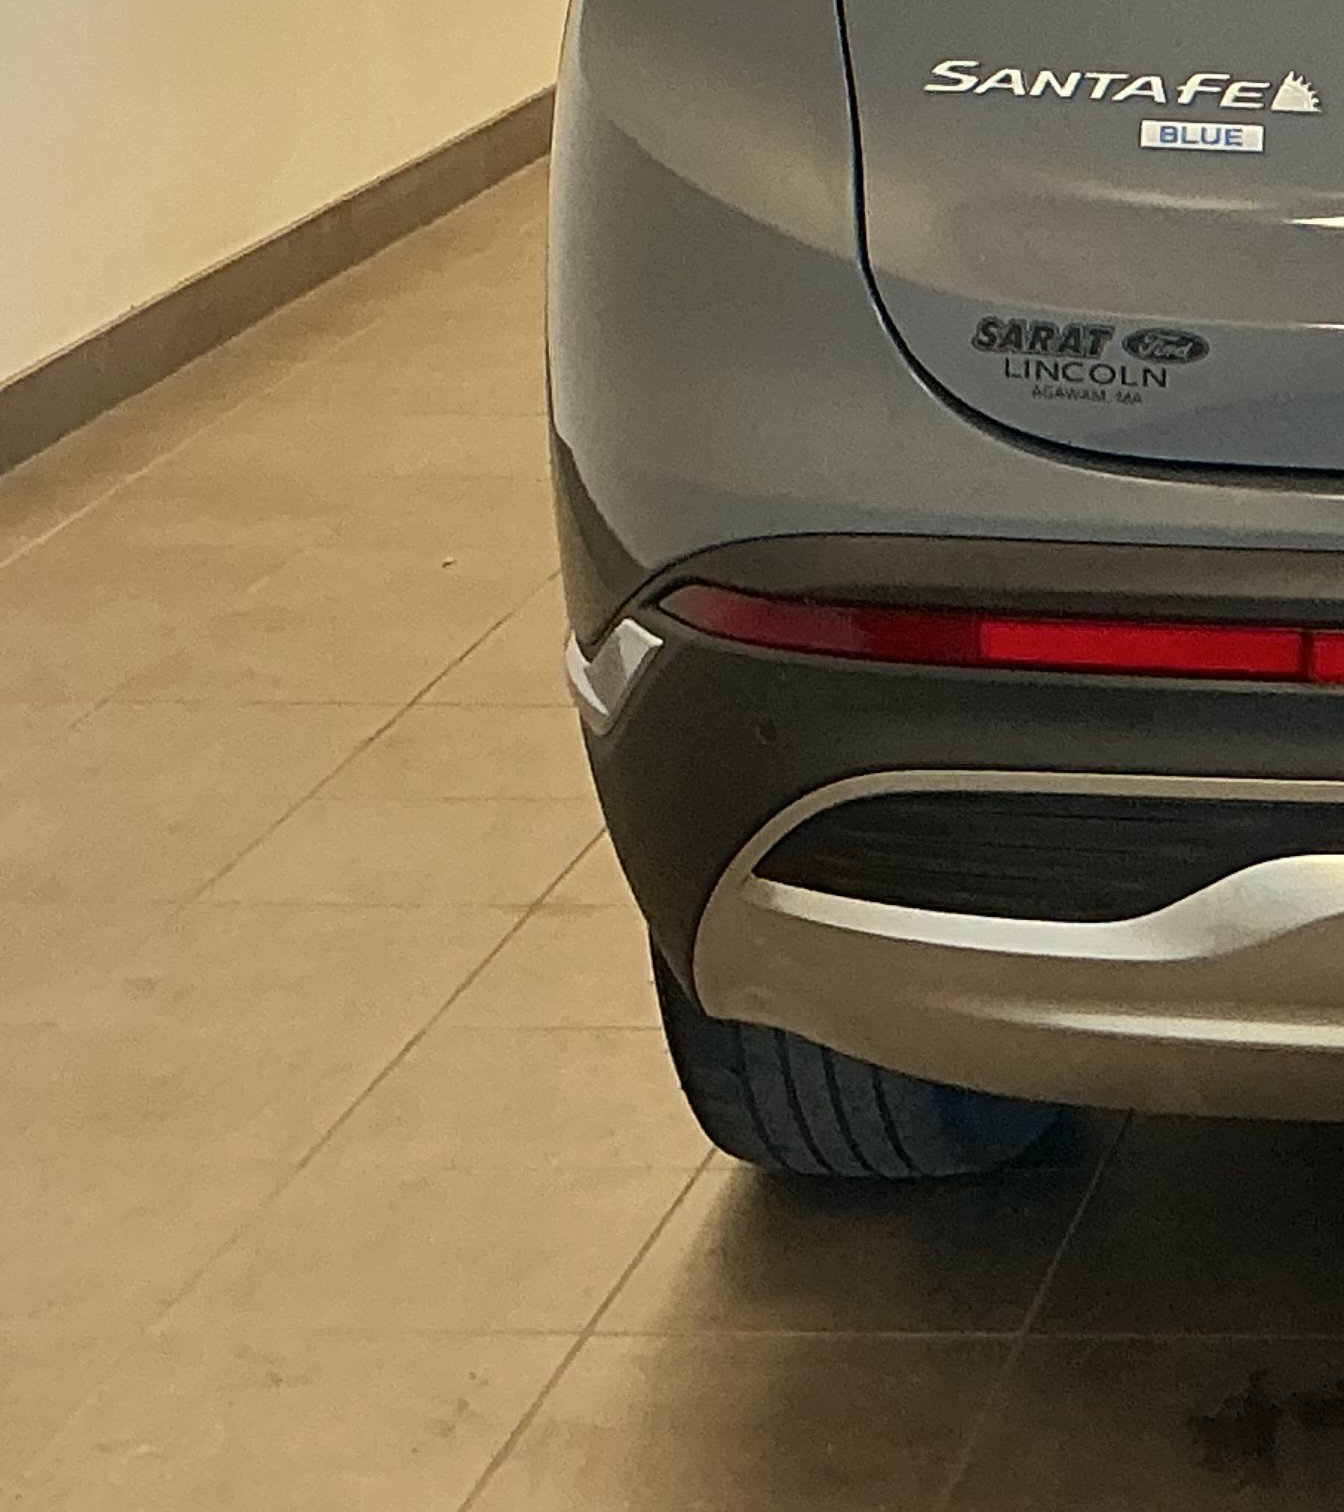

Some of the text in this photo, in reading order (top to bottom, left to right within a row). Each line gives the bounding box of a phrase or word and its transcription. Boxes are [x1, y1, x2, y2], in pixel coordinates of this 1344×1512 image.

[1158, 125, 1245, 147] BLUE
[971, 316, 1116, 360] SARAT
[1004, 356, 1168, 388] LINCOLN
